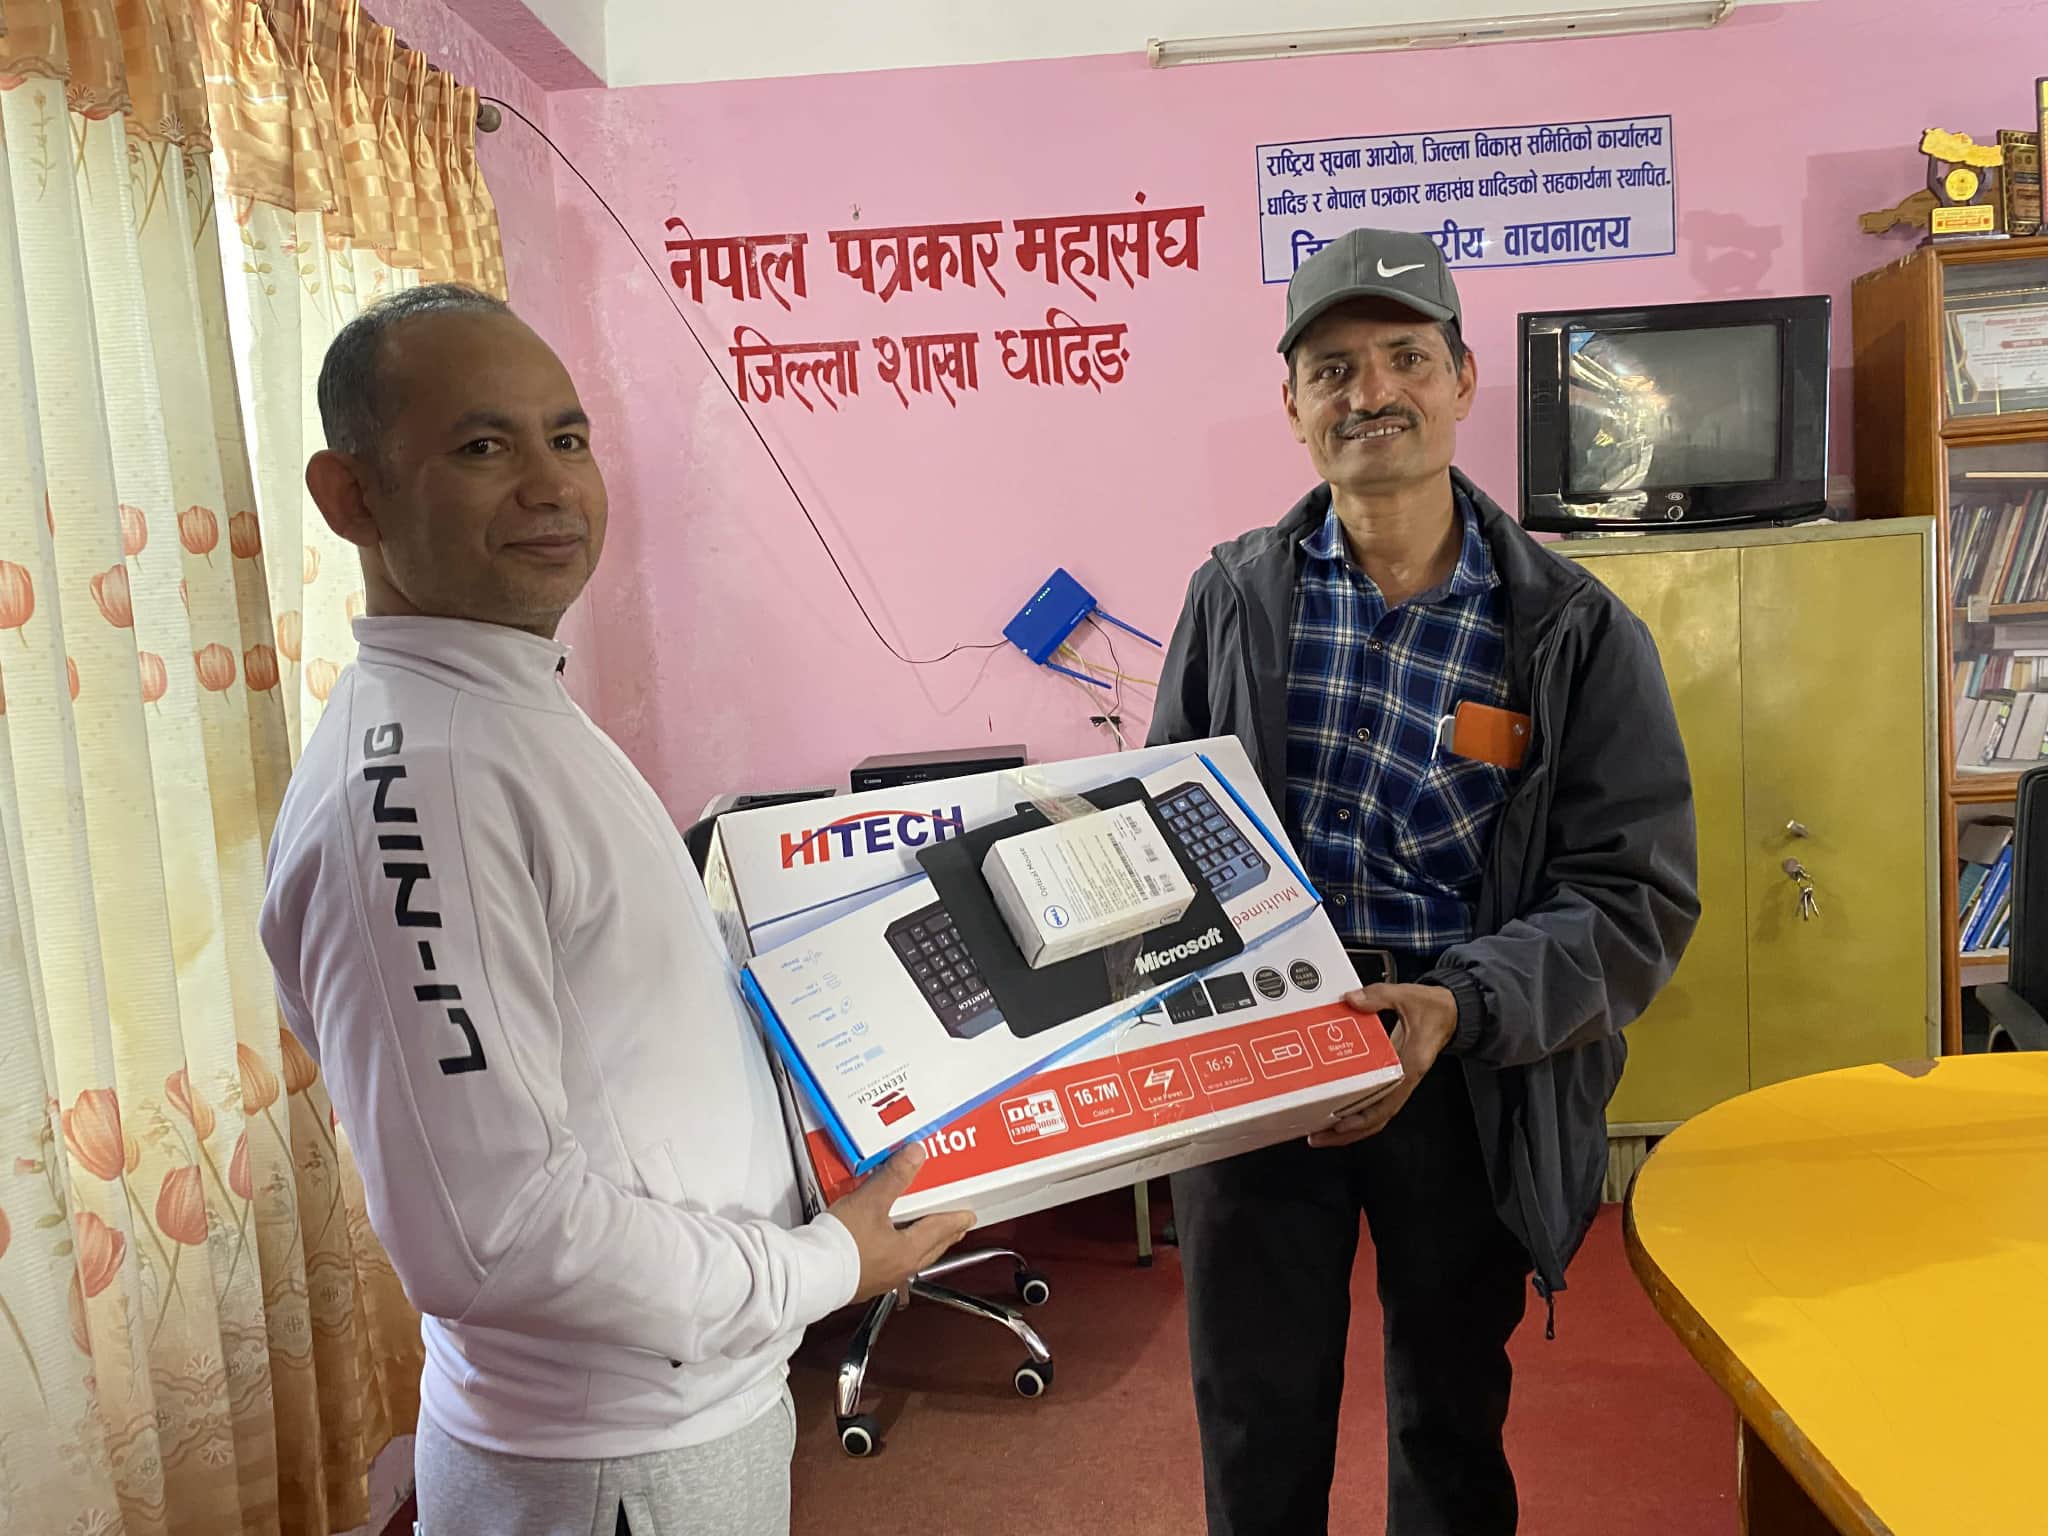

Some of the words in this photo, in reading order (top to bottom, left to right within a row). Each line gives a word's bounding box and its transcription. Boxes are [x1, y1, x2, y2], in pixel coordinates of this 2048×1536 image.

[1267, 149, 1315, 177] राष्ट्रिय
[1320, 150, 1361, 177] सूचना
[1423, 137, 1470, 163] जिल्ला
[1475, 132, 1522, 158] विकास
[1527, 125, 1592, 155] समितिको
[1597, 123, 1663, 149] कार्यालय
[1313, 193, 1323, 213] र
[1327, 186, 1366, 210] नेपाल
[1371, 184, 1421, 207] पत्रकार
[1425, 177, 1474, 203] महासंघ
[1543, 166, 1612, 194] सहकार्यमा
[665, 217, 808, 311] नेपाल
[828, 220, 1006, 302] पत्रकार
[1013, 191, 1205, 301] महासंघ
[1424, 218, 1485, 263] रीय
[1504, 216, 1631, 256] वाचनालय
[729, 325, 860, 413] जिल्ला
[873, 331, 979, 409] शाखा
[994, 307, 1130, 395] धादिङ
[779, 804, 966, 870] HITECH
[1019, 847, 1035, 871] Mouse
[1032, 870, 1049, 897] Optical
[1133, 927, 1224, 976] Microsoft
[1206, 1056, 1233, 1073] 16:9
[1258, 1043, 1302, 1064] LED
[857, 1071, 909, 1106] JEENTECH
[1074, 1081, 1119, 1107] 16.7M
[1007, 1100, 1055, 1124] DCR
[1092, 1107, 1115, 1118] Colors
